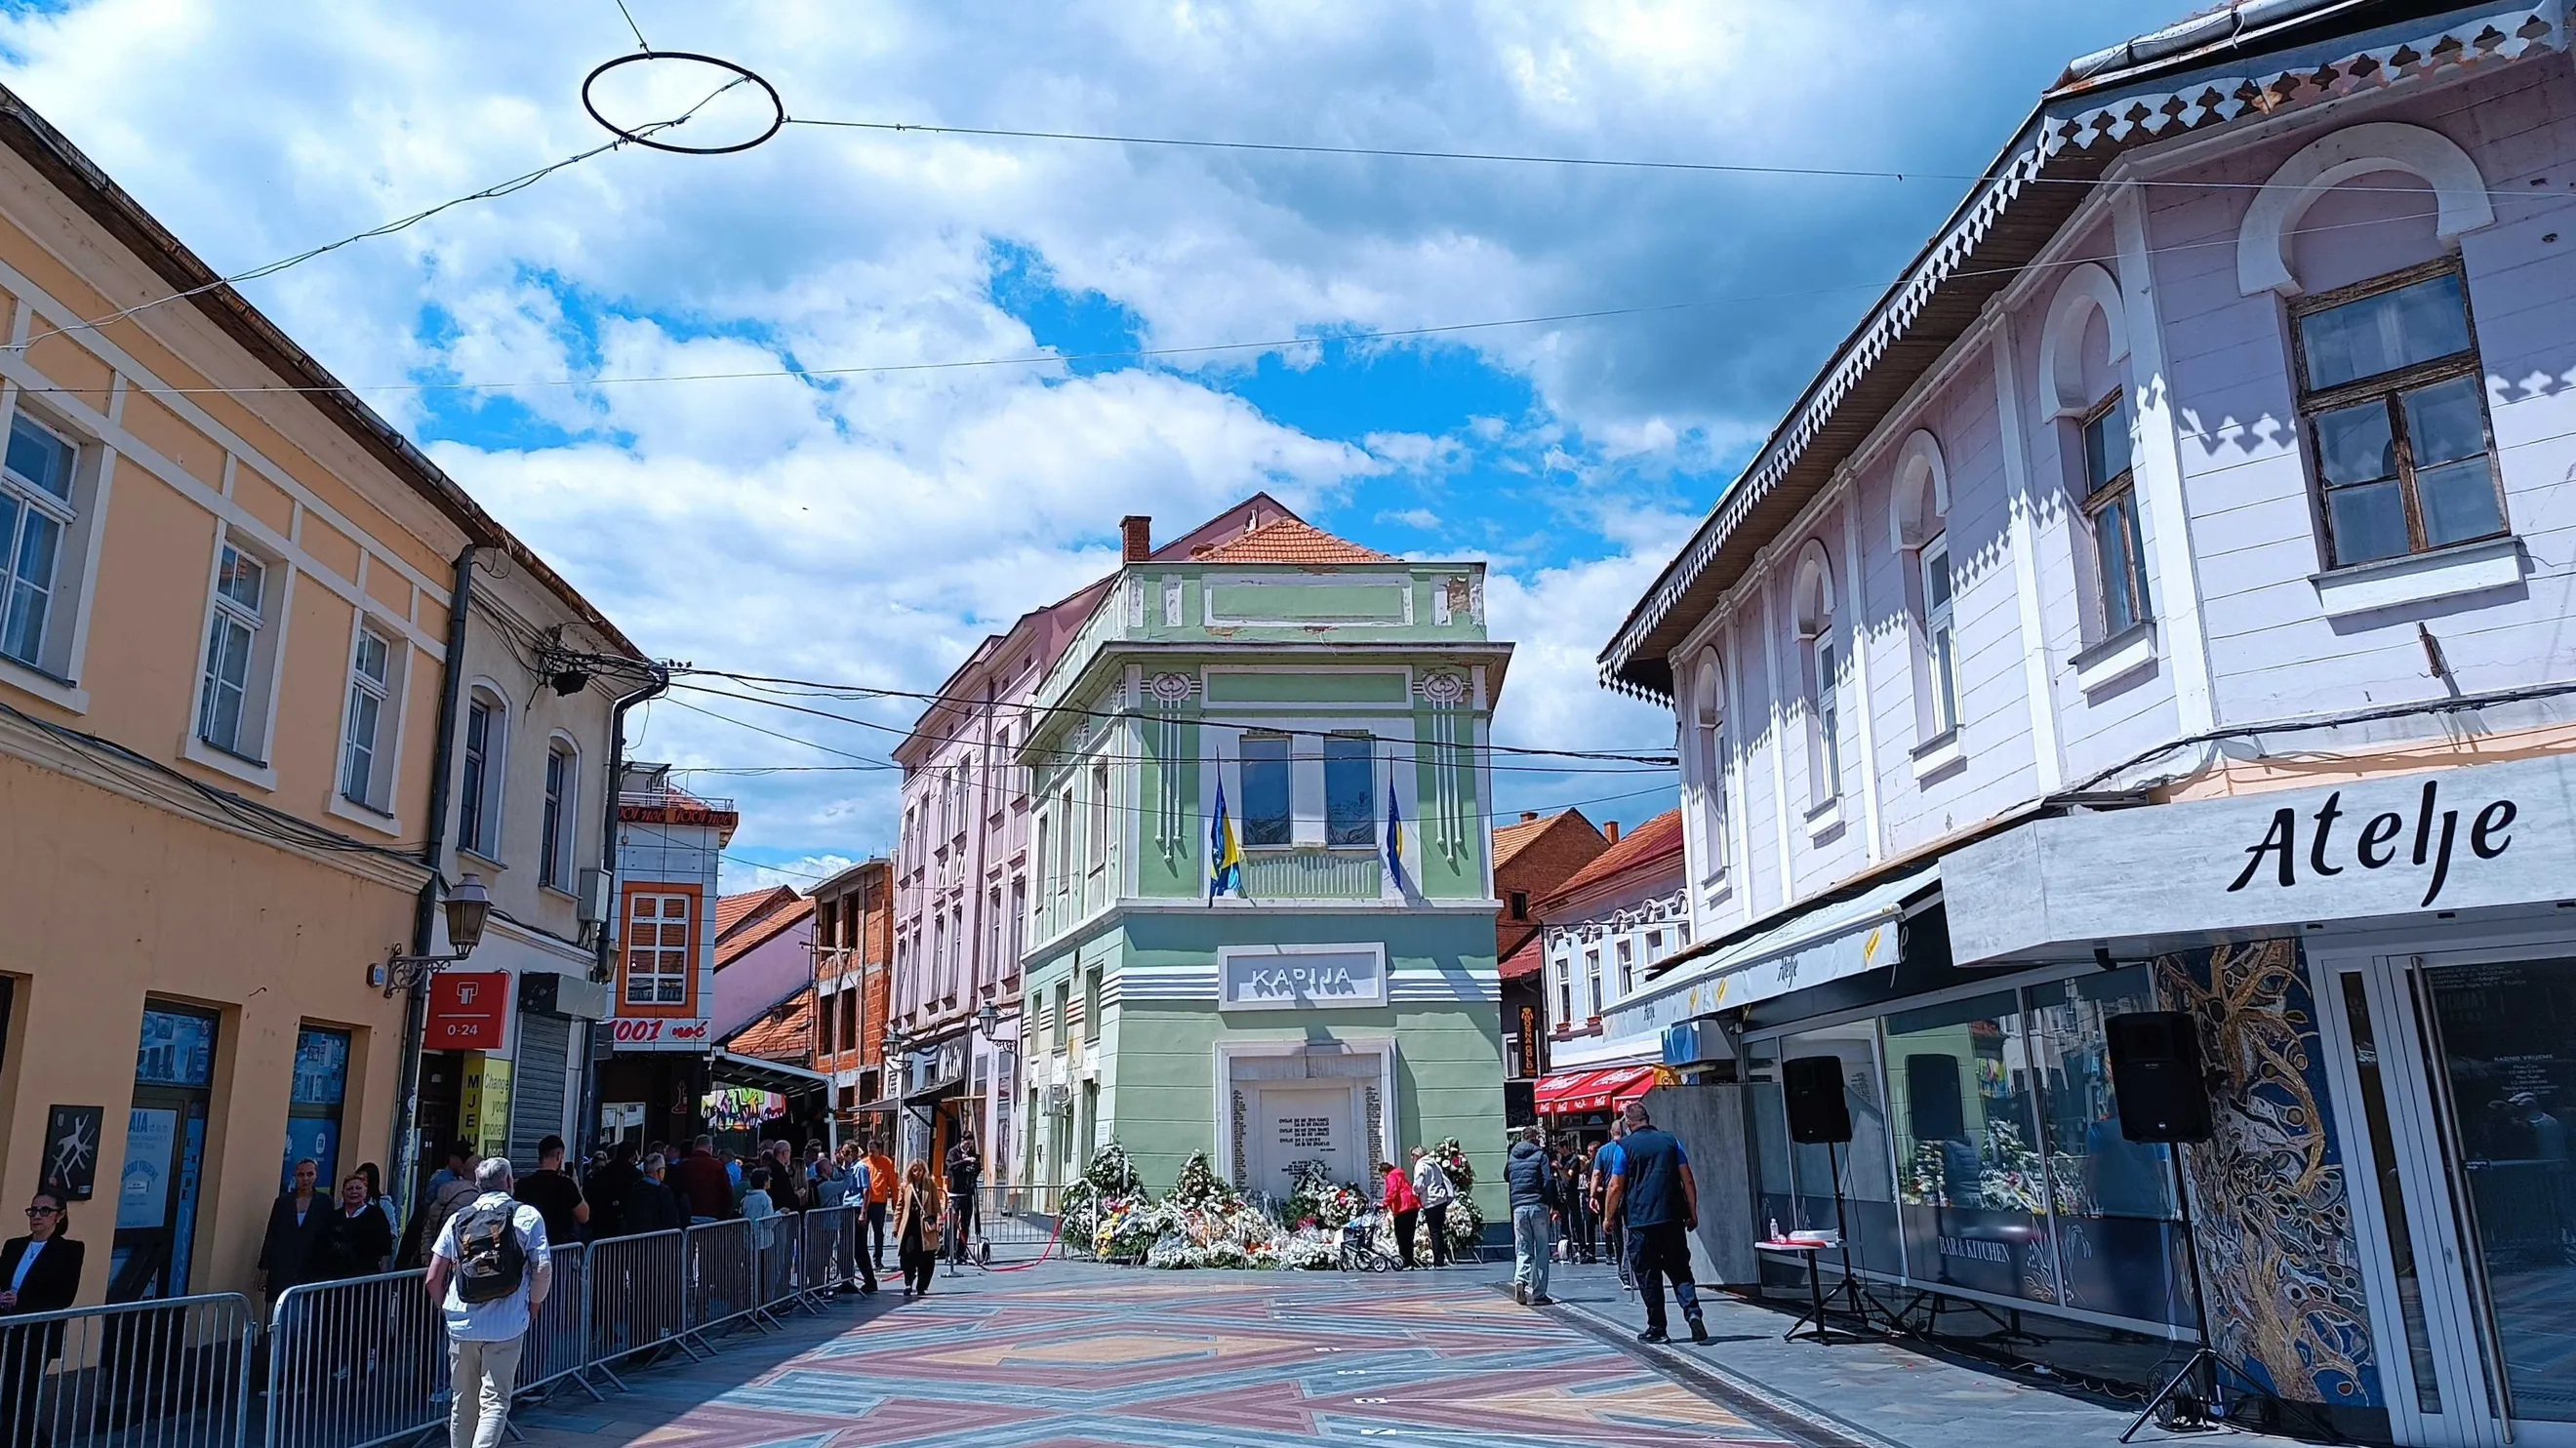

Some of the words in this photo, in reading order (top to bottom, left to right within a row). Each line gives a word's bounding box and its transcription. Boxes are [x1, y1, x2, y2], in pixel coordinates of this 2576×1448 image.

[618, 807, 638, 820] 001
[2226, 779, 2517, 908] Atelje
[1251, 967, 1351, 987] KAPIJA
[447, 1025, 478, 1036] 0-24
[484, 1073, 509, 1094] Change
[491, 1100, 508, 1117] your
[482, 1122, 505, 1140] money
[1938, 1235, 1958, 1257] BAR
[1958, 1238, 1966, 1258] &
[1965, 1238, 2011, 1265] KITCHEN
